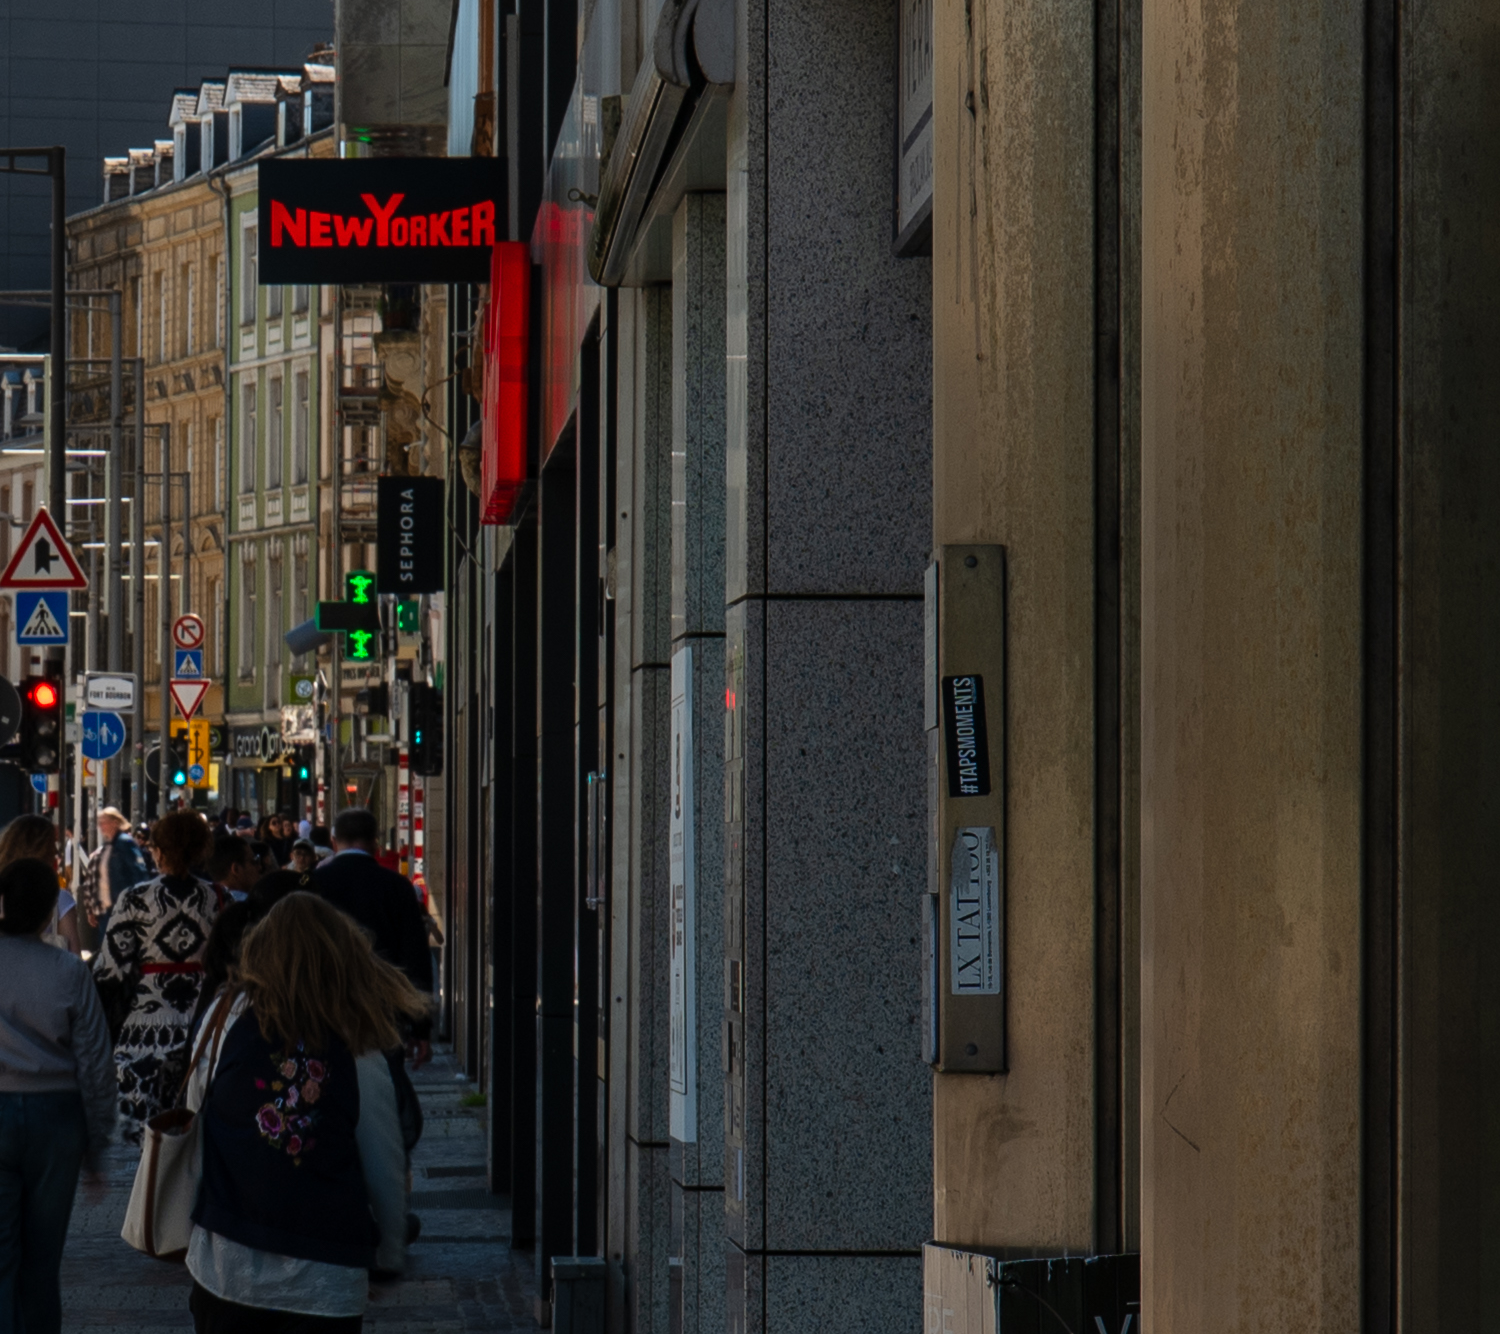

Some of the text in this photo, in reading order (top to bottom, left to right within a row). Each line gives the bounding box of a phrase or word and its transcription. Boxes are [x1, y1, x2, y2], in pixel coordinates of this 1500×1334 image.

[400, 488, 415, 582] SEPHORA
[953, 676, 979, 795] #TAPSMOMENTS
[956, 954, 982, 990] LX
